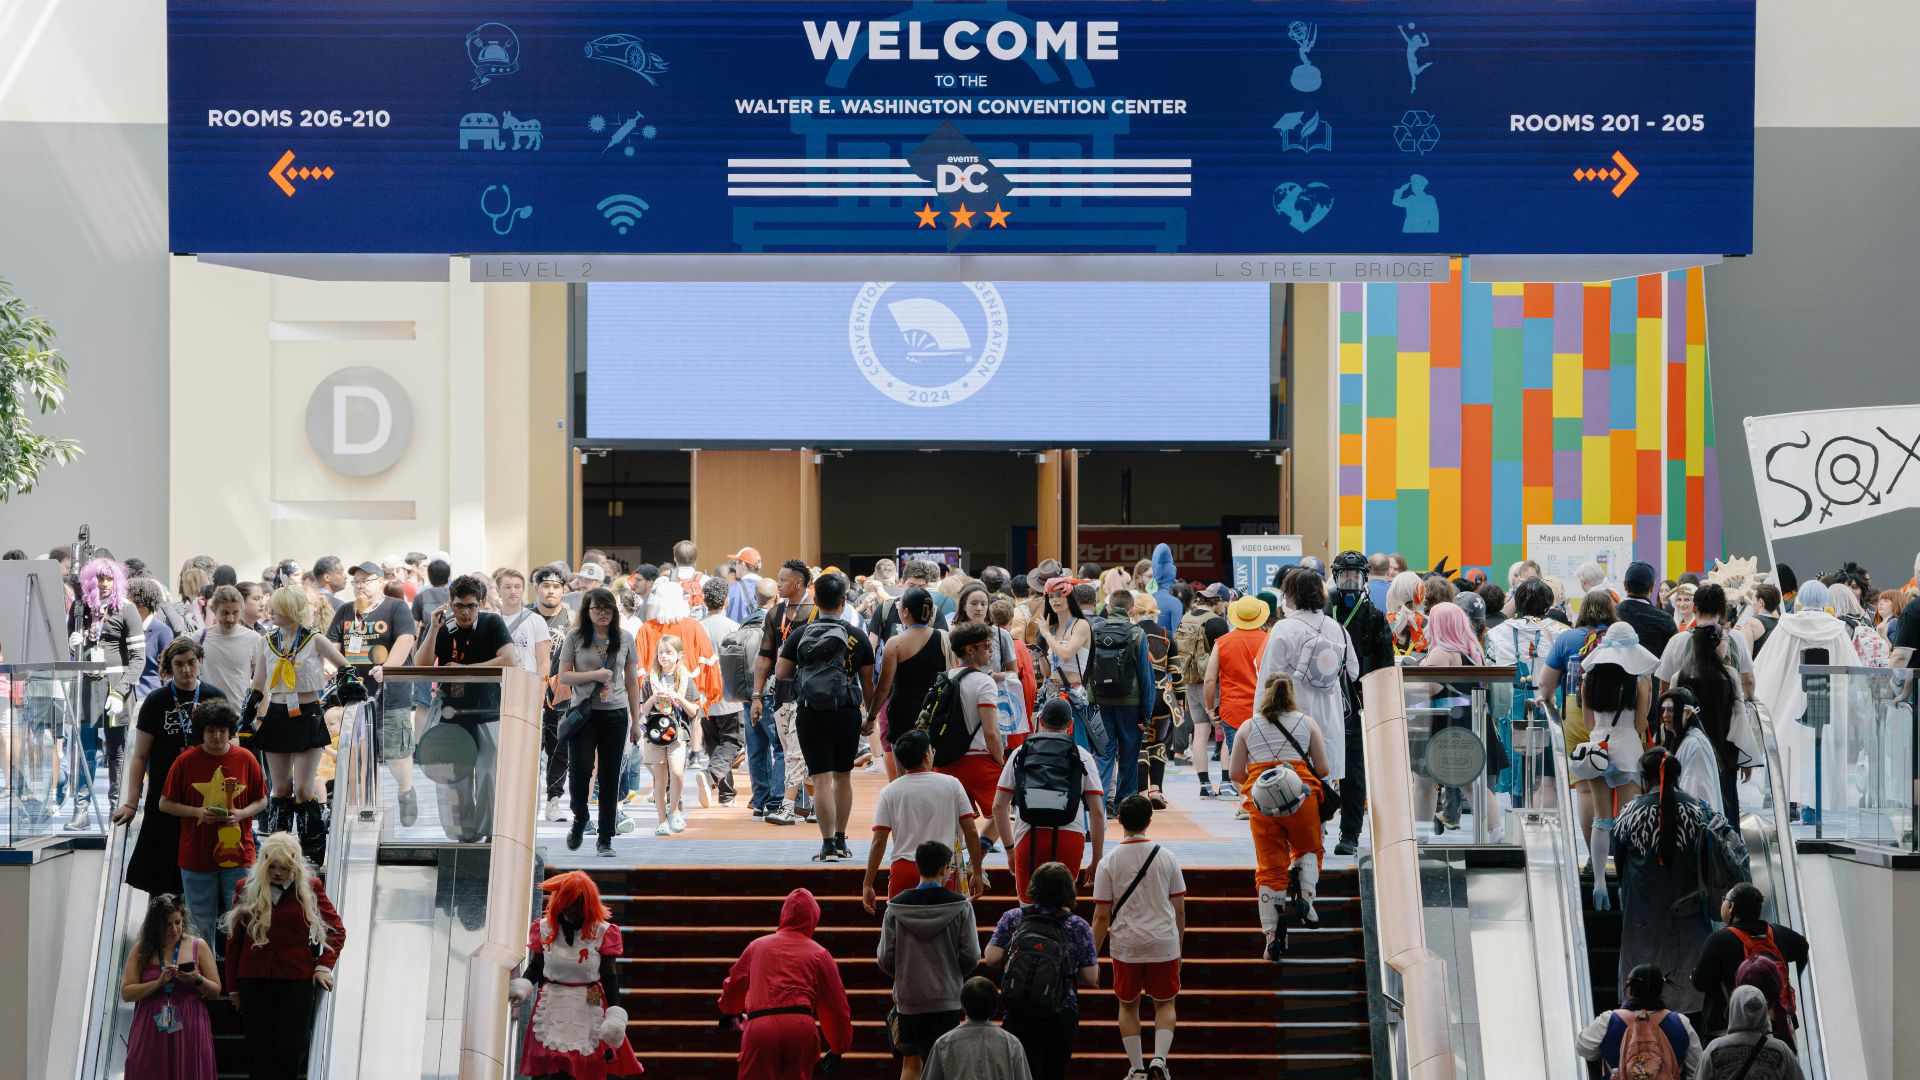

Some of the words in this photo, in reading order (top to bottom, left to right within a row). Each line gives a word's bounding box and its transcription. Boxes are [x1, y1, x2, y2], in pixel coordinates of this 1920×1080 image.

[803, 20, 1119, 61] WELCOME
[935, 75, 955, 87] TO
[959, 75, 988, 87] THE
[735, 99, 813, 114] WALTER
[819, 99, 835, 114] E.
[841, 99, 972, 115] WASHINGTON
[977, 99, 1106, 115] CONVENTION
[1112, 99, 1187, 115] CENTER
[208, 110, 293, 127] ROOMS
[299, 109, 391, 128] 206-210
[1510, 114, 1595, 132] ROOMS
[1601, 114, 1639, 132] 201
[1661, 114, 1705, 132] 205
[947, 155, 979, 163] events
[936, 164, 989, 194] DC
[486, 262, 565, 278] LEVEL
[582, 262, 593, 278] 2
[1215, 263, 1225, 277] L
[1240, 262, 1336, 278] STREET
[1355, 262, 1435, 278] BRIDGE
[907, 389, 951, 403] 2024
[333, 385, 393, 455] D
[1539, 534, 1561, 543] Maps
[1561, 534, 1577, 542] and
[1578, 534, 1624, 542] Information
[1241, 544, 1262, 552] VIDEO
[1263, 544, 1291, 552] GAMING
[343, 619, 388, 635] PLUTO
